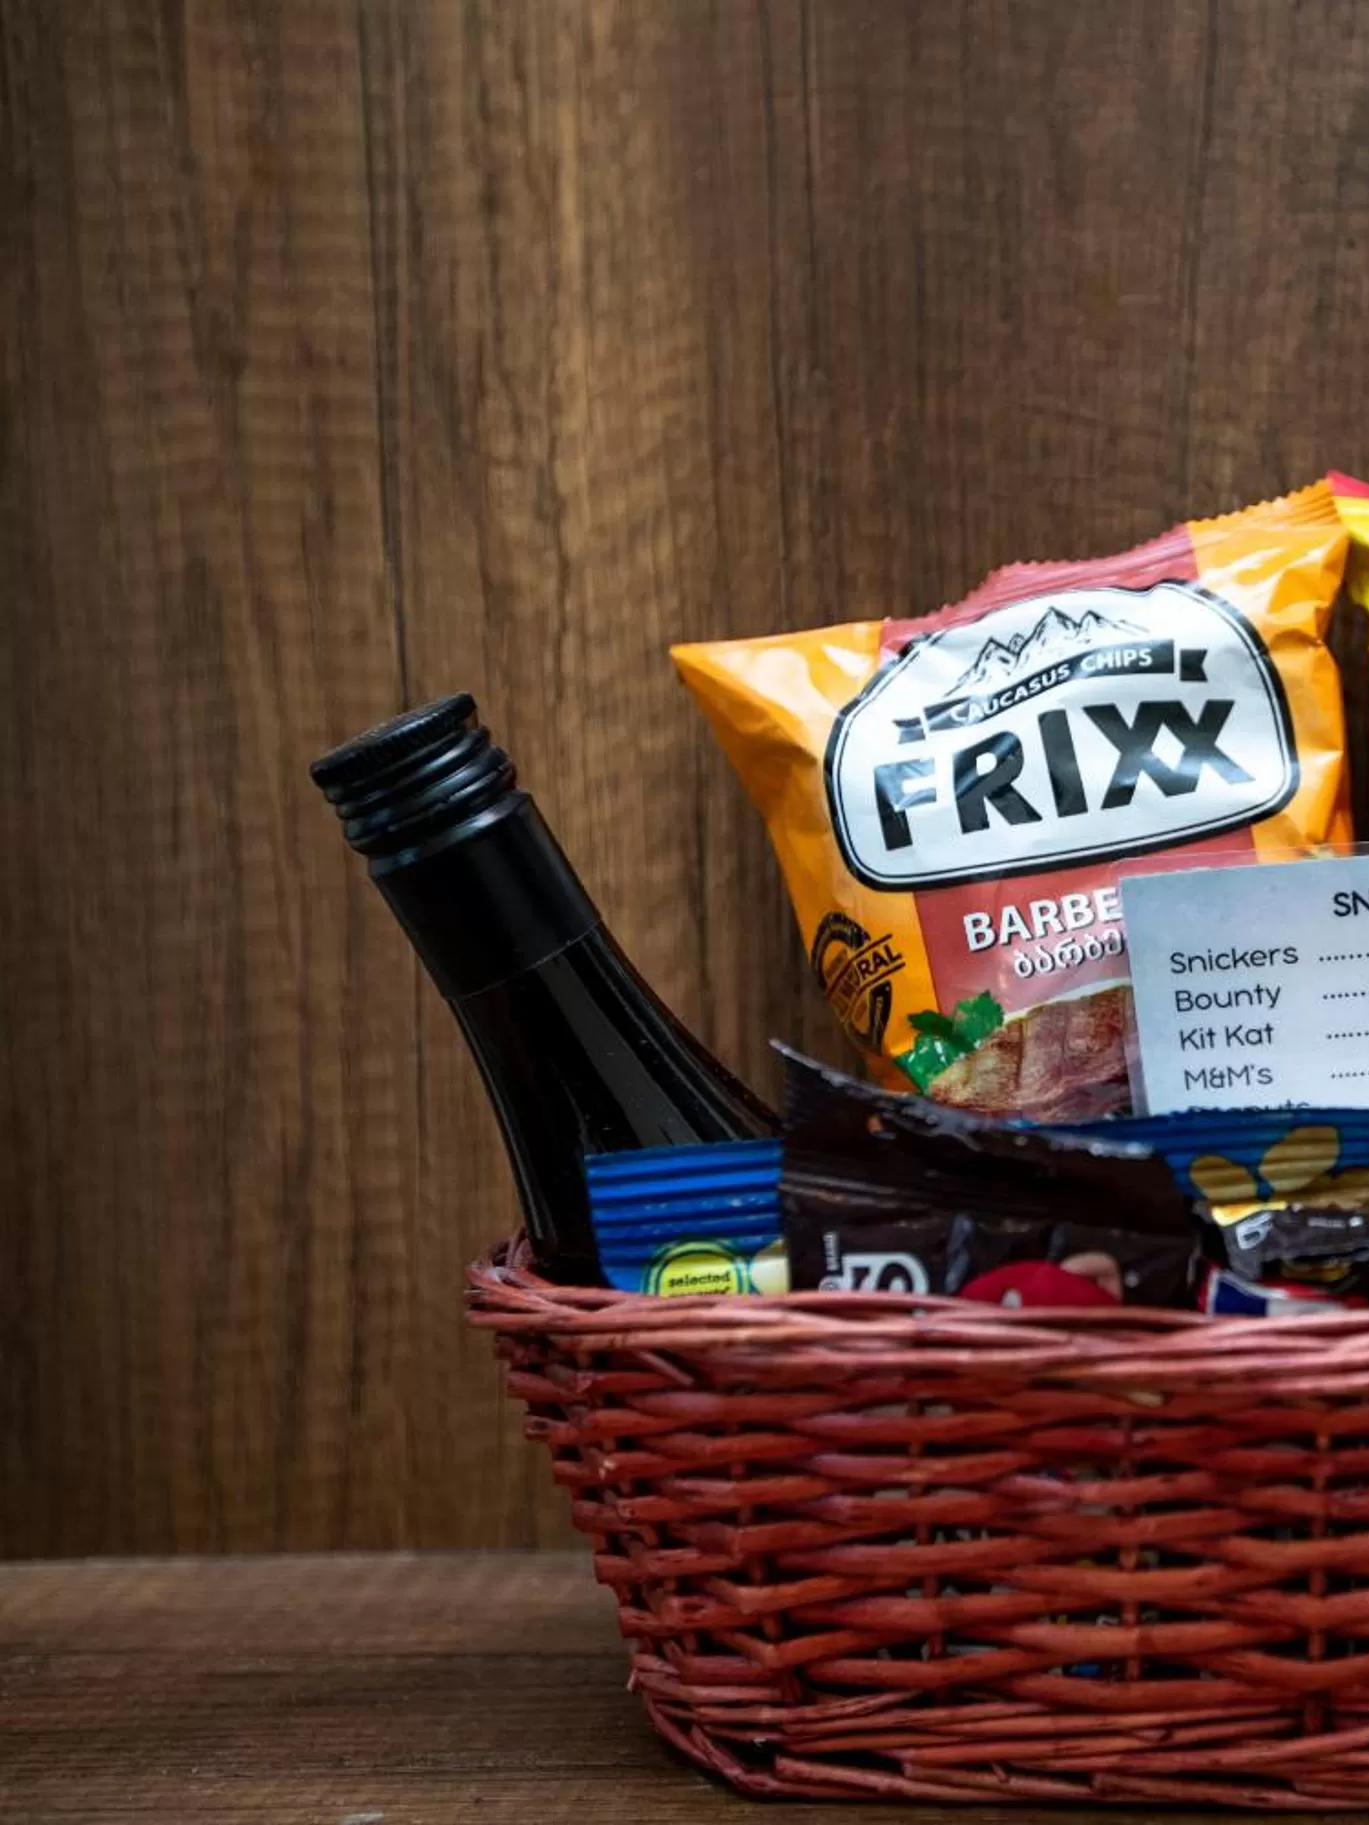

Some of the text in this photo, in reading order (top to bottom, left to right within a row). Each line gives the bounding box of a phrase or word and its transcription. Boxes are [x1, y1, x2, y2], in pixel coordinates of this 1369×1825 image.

[949, 648, 1153, 723] CAUCASUS CHIPS
[874, 699, 1255, 851] FRIXX
[963, 886, 1125, 953] BARBE
[1169, 946, 1300, 974] Snickers
[1174, 983, 1282, 1013] Bounty
[1178, 1026, 1217, 1052] Kit
[1224, 1022, 1275, 1048] Kat
[1183, 1063, 1274, 1092] M&M's
[668, 1270, 731, 1288] selected
